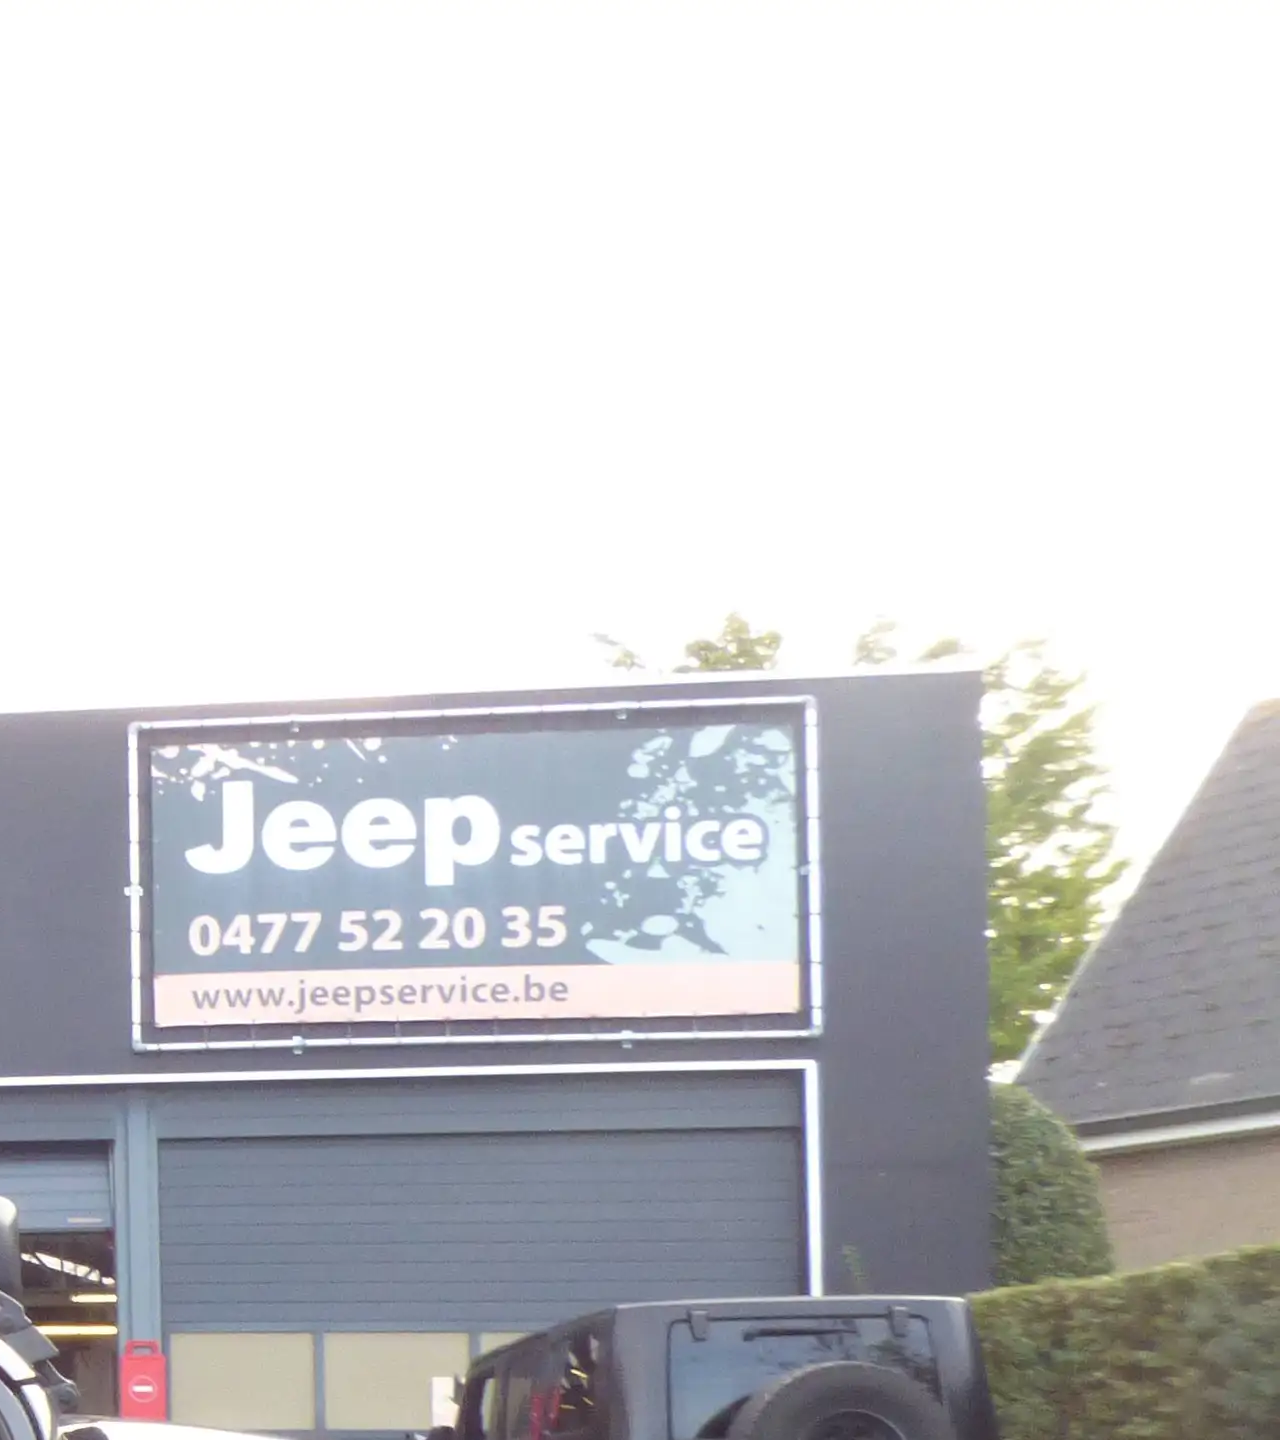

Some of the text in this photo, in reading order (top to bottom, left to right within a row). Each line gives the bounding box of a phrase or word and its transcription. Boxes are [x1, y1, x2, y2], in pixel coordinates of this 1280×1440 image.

[184, 779, 765, 886] Jeep service
[188, 905, 568, 956] 0477 52 20 35
[192, 974, 569, 1014] www.jeepservice.be
